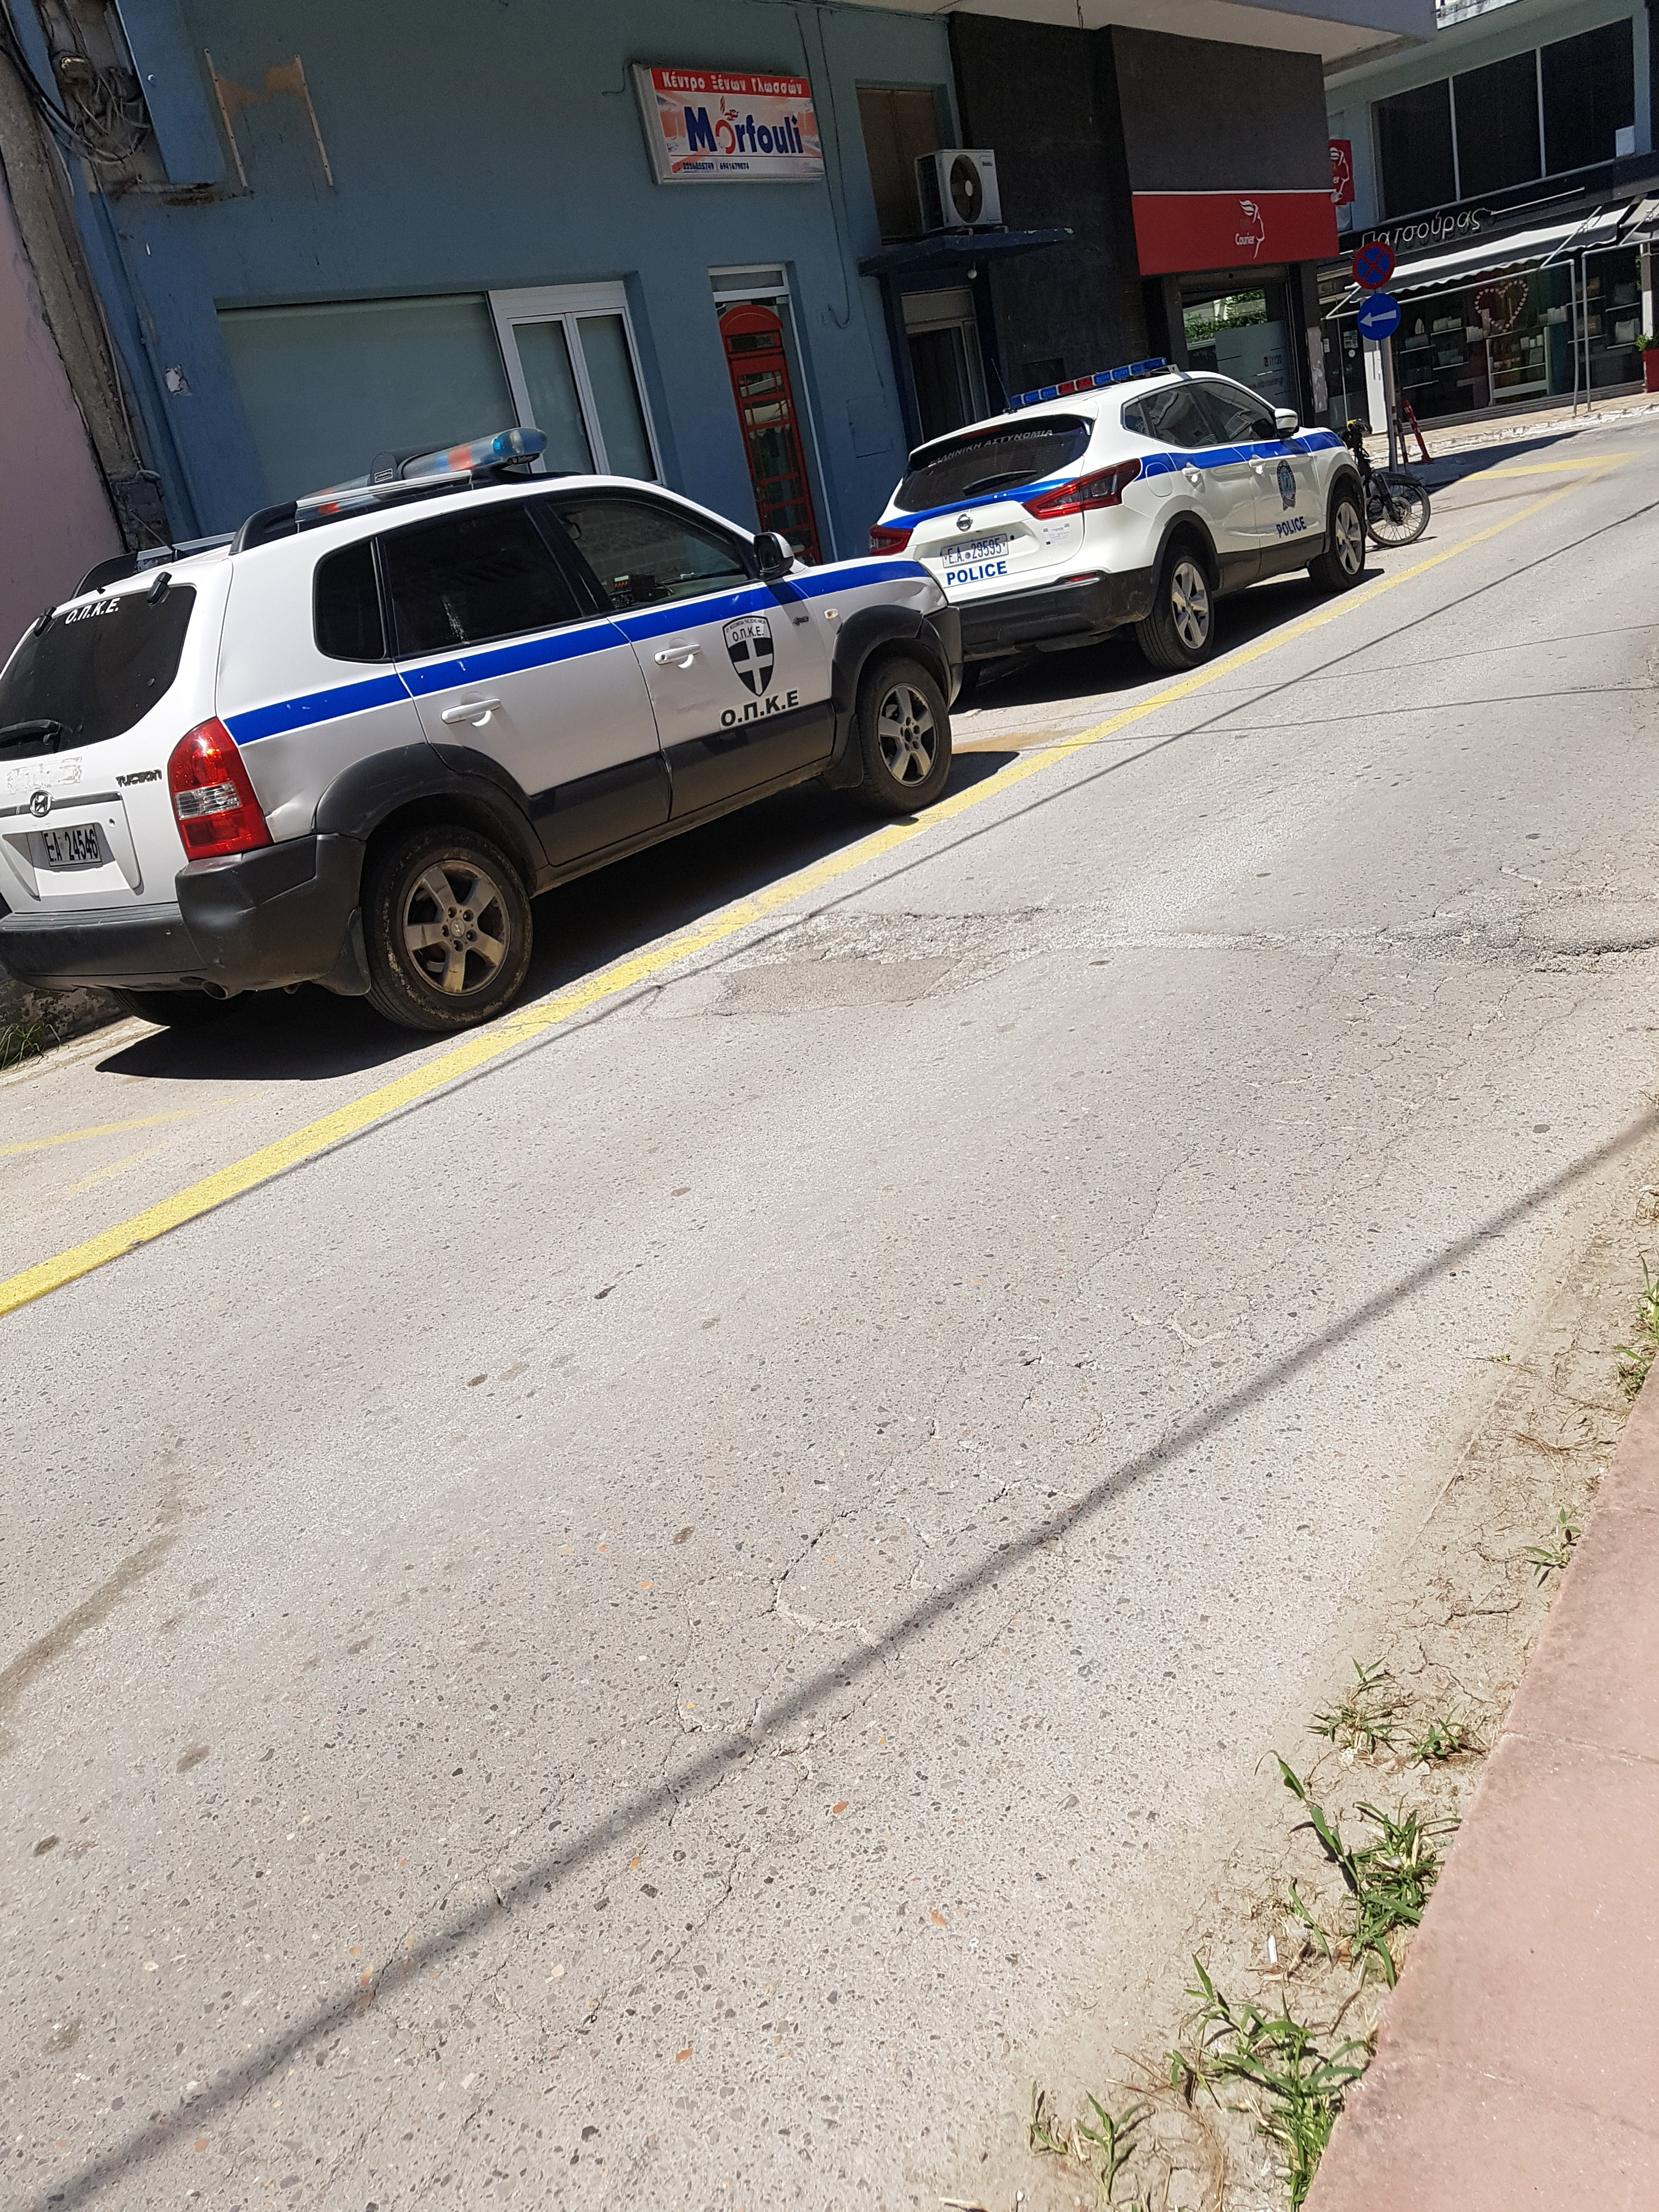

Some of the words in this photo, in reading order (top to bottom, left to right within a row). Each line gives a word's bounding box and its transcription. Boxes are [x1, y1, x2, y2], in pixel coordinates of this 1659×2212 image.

[662, 71, 706, 92] Κέντρο
[710, 75, 746, 91] Ξένων
[751, 77, 802, 94] Γλωσσών
[684, 106, 804, 155] Morfouli
[1362, 207, 1486, 247] Πατσούρας
[1235, 232, 1255, 246] Courier
[984, 430, 1053, 448] ΑΣΤΥΝΟΜΙΑ
[1276, 516, 1307, 539] POLICE
[971, 537, 1002, 559] 29595
[946, 561, 1008, 585] POLICE
[65, 597, 121, 624] Ο.Π.Κ.Ε.
[732, 625, 764, 642] Ο.Π.Κ.Ε.
[721, 690, 799, 727] Ο.Π.Κ.Ε
[65, 828, 99, 860] 24546
